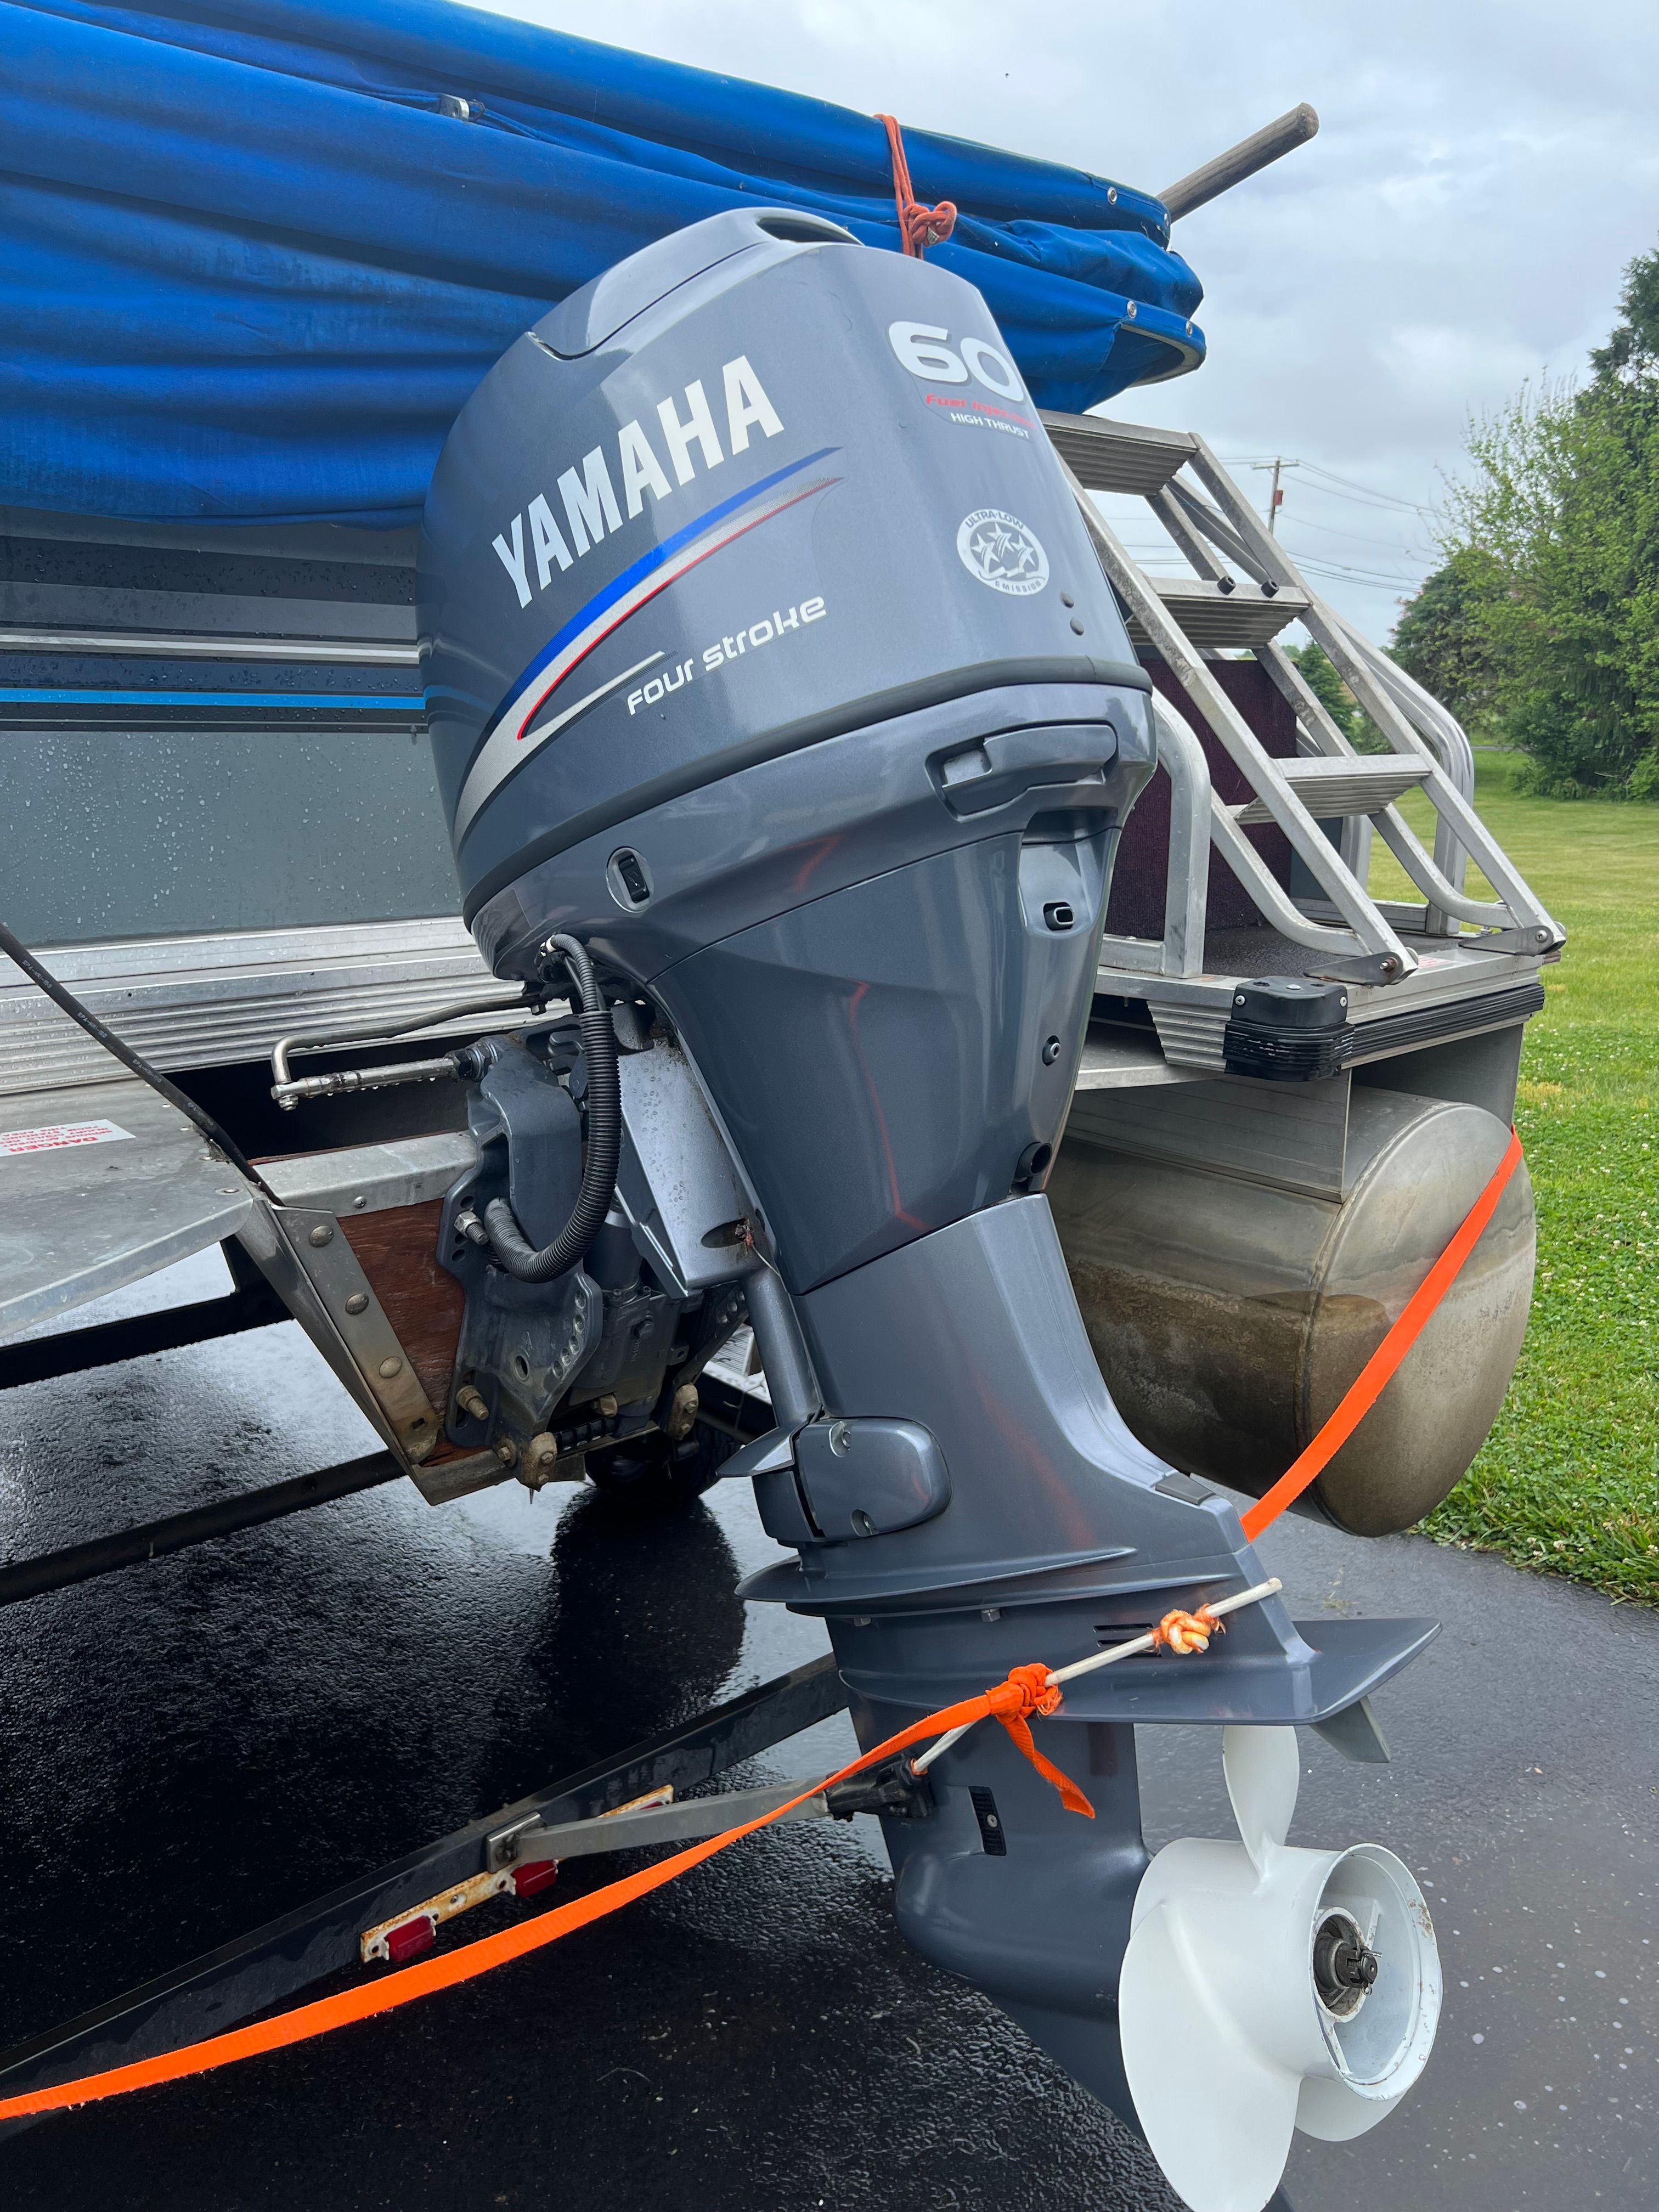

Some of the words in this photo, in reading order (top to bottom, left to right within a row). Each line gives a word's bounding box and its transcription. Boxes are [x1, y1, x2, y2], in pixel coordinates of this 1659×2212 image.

[889, 321, 1024, 402] 60
[926, 394, 966, 408] Fuel
[950, 412, 984, 426] HIGH
[984, 417, 1030, 439] THRUST
[492, 355, 784, 608] YAMAHA
[995, 580, 1042, 593] EMISSION
[64, 1130, 112, 1138] SERIOUS
[3, 1137, 59, 1148] ACCIDENT
[9, 1136, 98, 1152] DANGER
